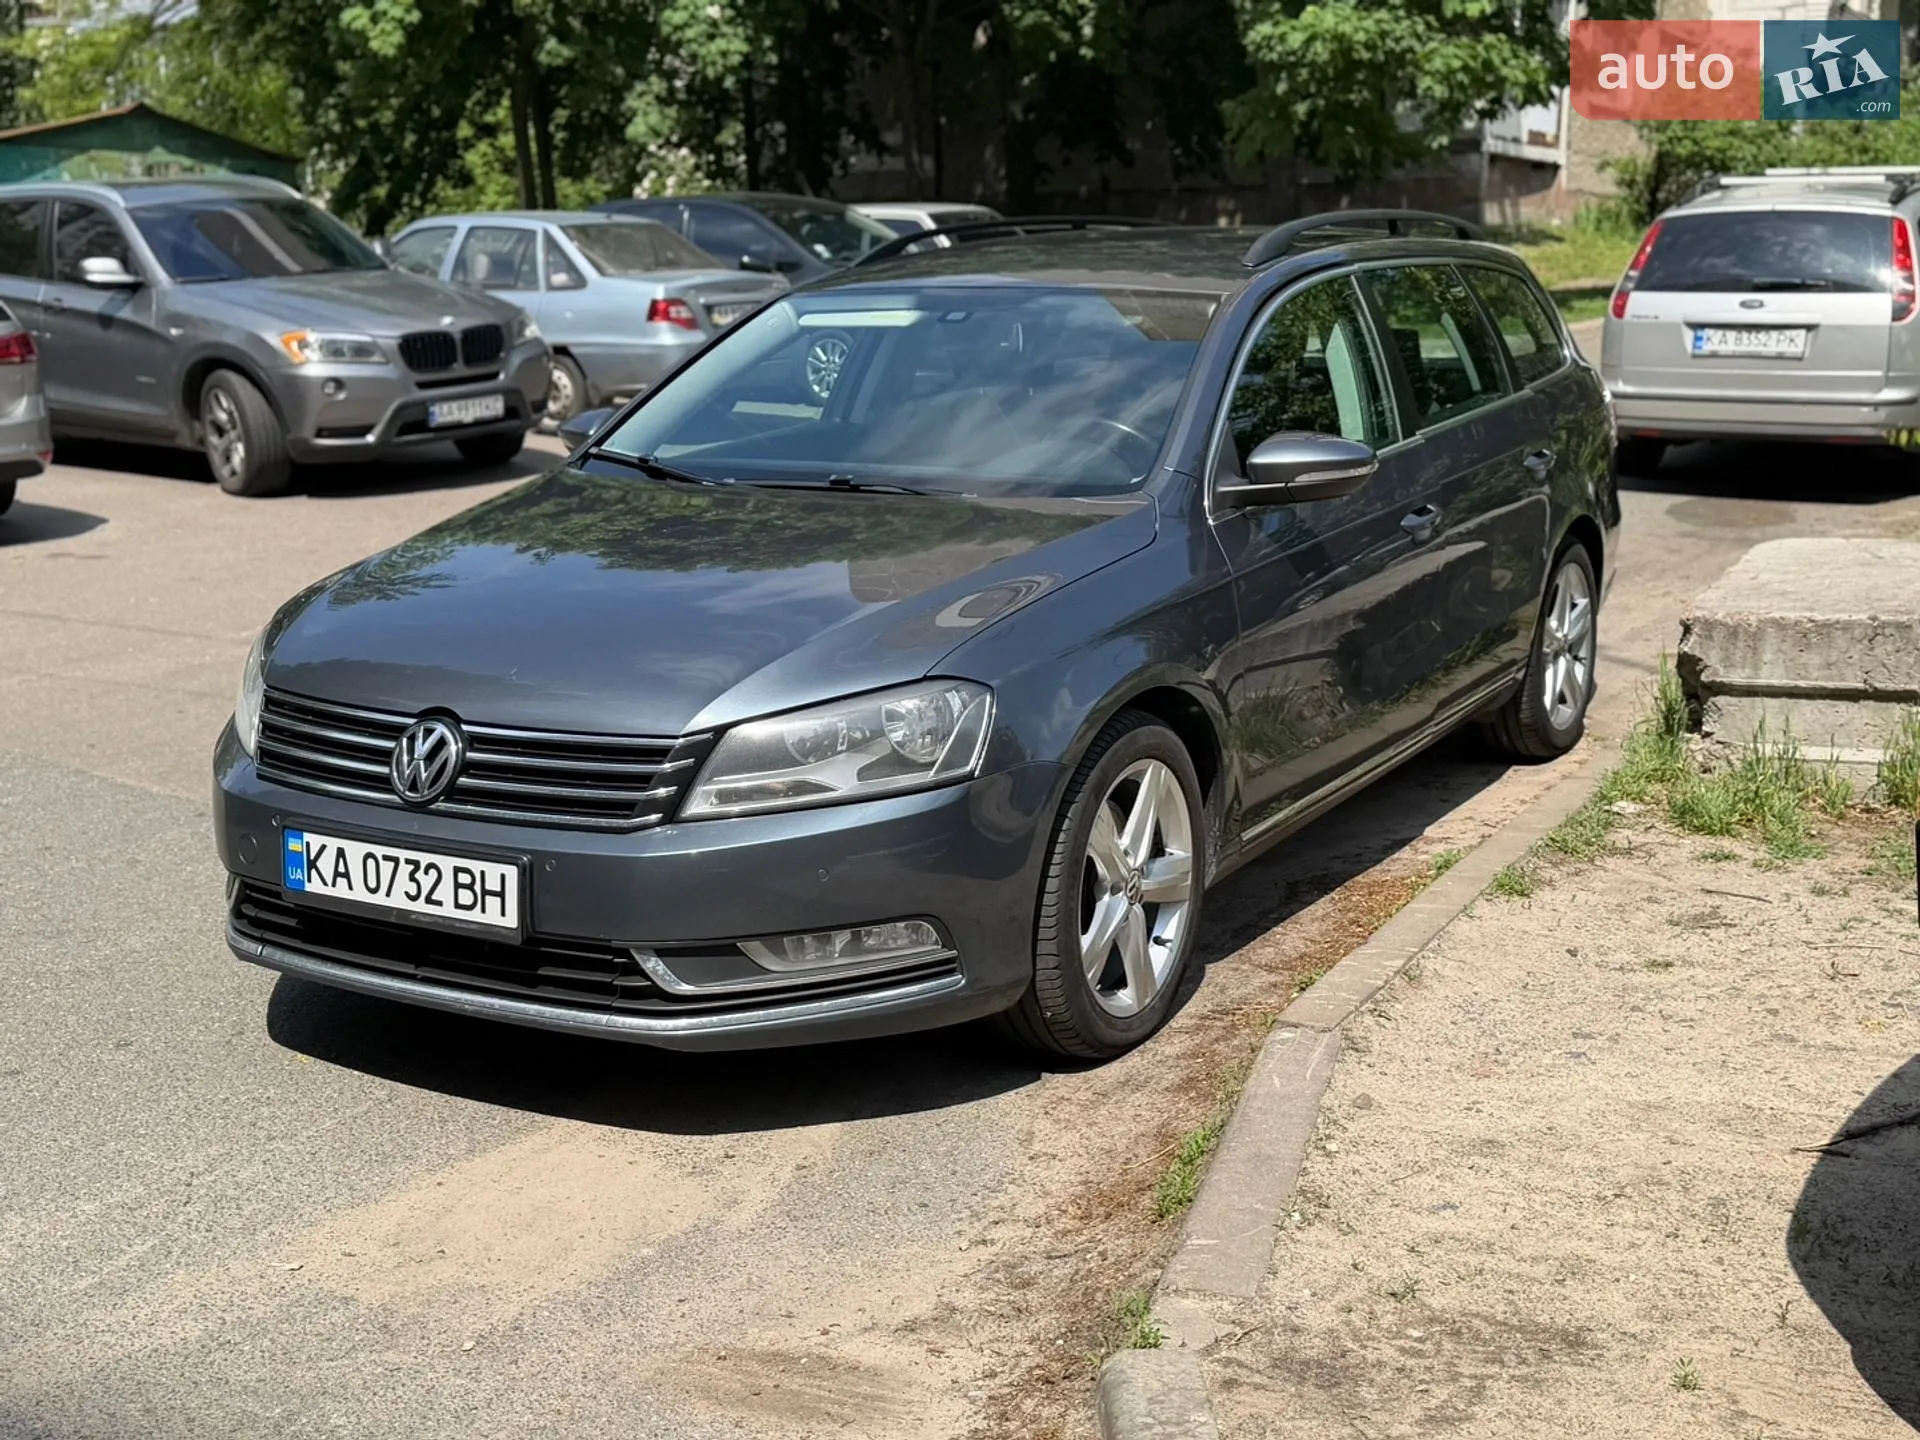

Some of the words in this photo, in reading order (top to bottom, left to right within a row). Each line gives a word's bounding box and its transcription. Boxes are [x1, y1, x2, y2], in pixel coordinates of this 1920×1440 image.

[288, 866, 304, 880] UA
[305, 840, 354, 891] KA
[362, 851, 443, 908] 0732
[453, 865, 506, 918] BH
